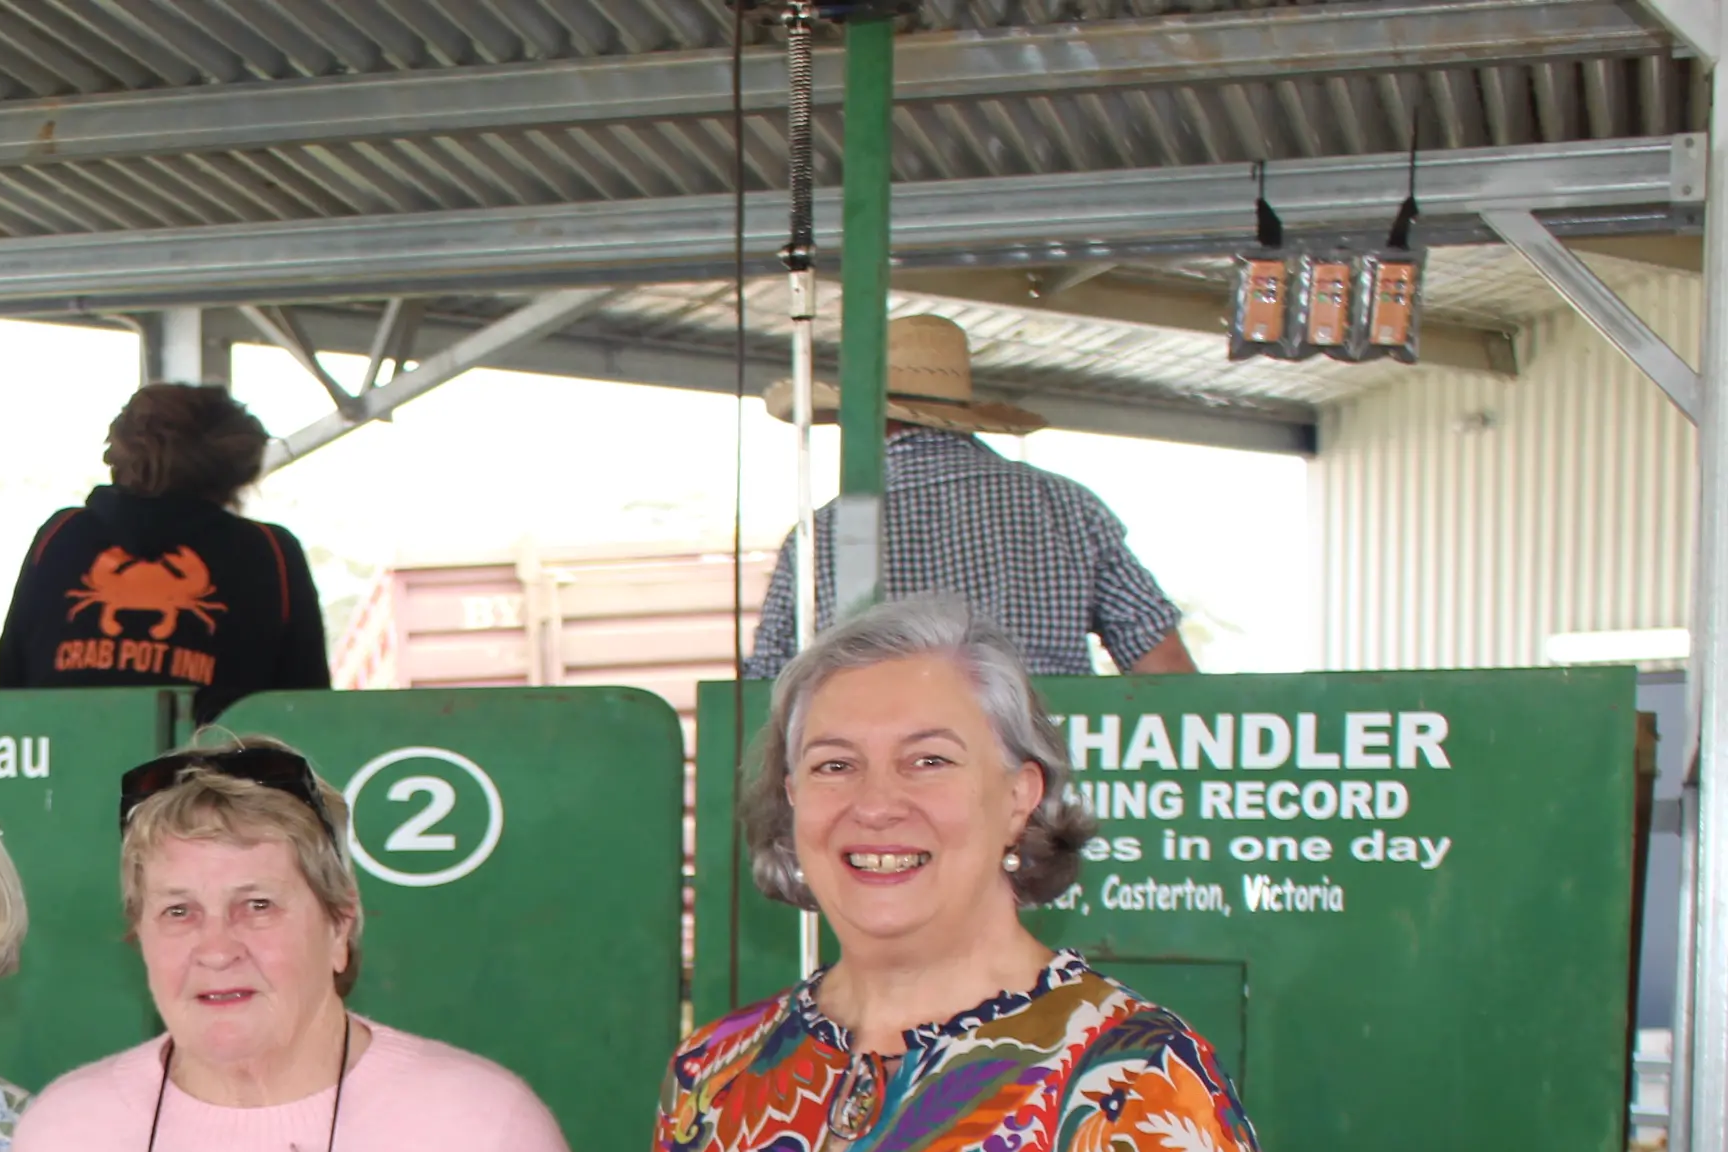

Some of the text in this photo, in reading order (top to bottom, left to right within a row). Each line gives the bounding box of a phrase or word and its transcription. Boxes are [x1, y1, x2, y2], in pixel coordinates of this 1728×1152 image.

[55, 640, 216, 686] CRAB POT INN
[1048, 712, 1451, 770] HANDLER
[384, 775, 458, 851] 2
[1200, 780, 1410, 820] RECORD
[1162, 829, 1211, 861] in
[1229, 835, 1333, 862] one
[1350, 828, 1451, 869] day
[1101, 873, 1232, 917] Casterton,
[1243, 873, 1345, 912] Victoria
